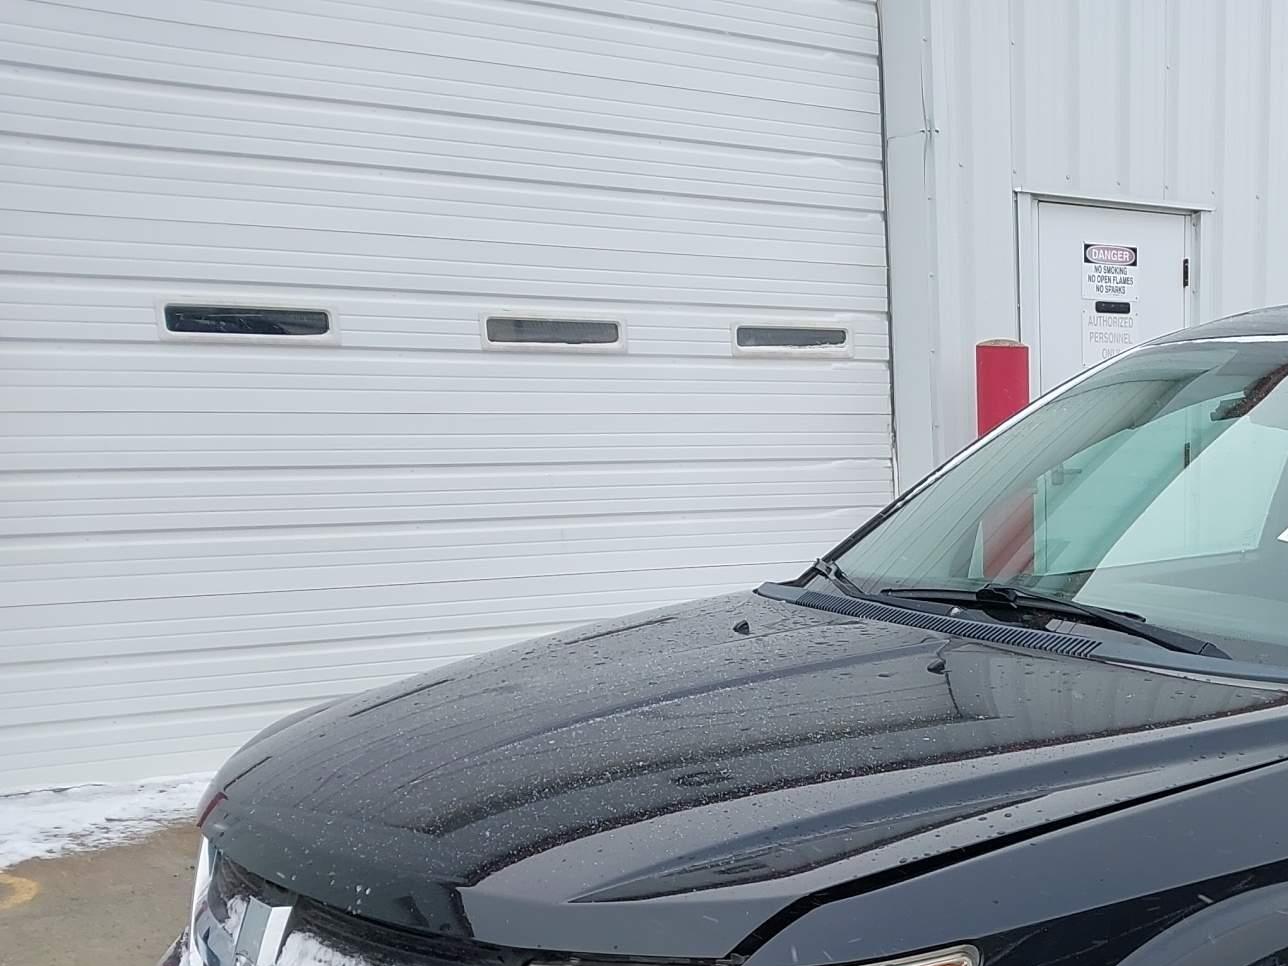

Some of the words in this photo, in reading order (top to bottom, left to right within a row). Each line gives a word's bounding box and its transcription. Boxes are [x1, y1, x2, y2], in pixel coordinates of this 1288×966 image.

[1092, 249, 1130, 261] DANGER
[1094, 265, 1102, 274] NO
[1103, 265, 1127, 275] SMOKING
[1088, 274, 1095, 283] NO
[1097, 275, 1111, 284] OPEN
[1113, 276, 1133, 285] FLAMES
[1096, 284, 1104, 293] NO
[1105, 285, 1125, 294] SPARKS
[1088, 315, 1134, 328] AUTHORIZED
[1090, 331, 1133, 344] PERSONNEL
